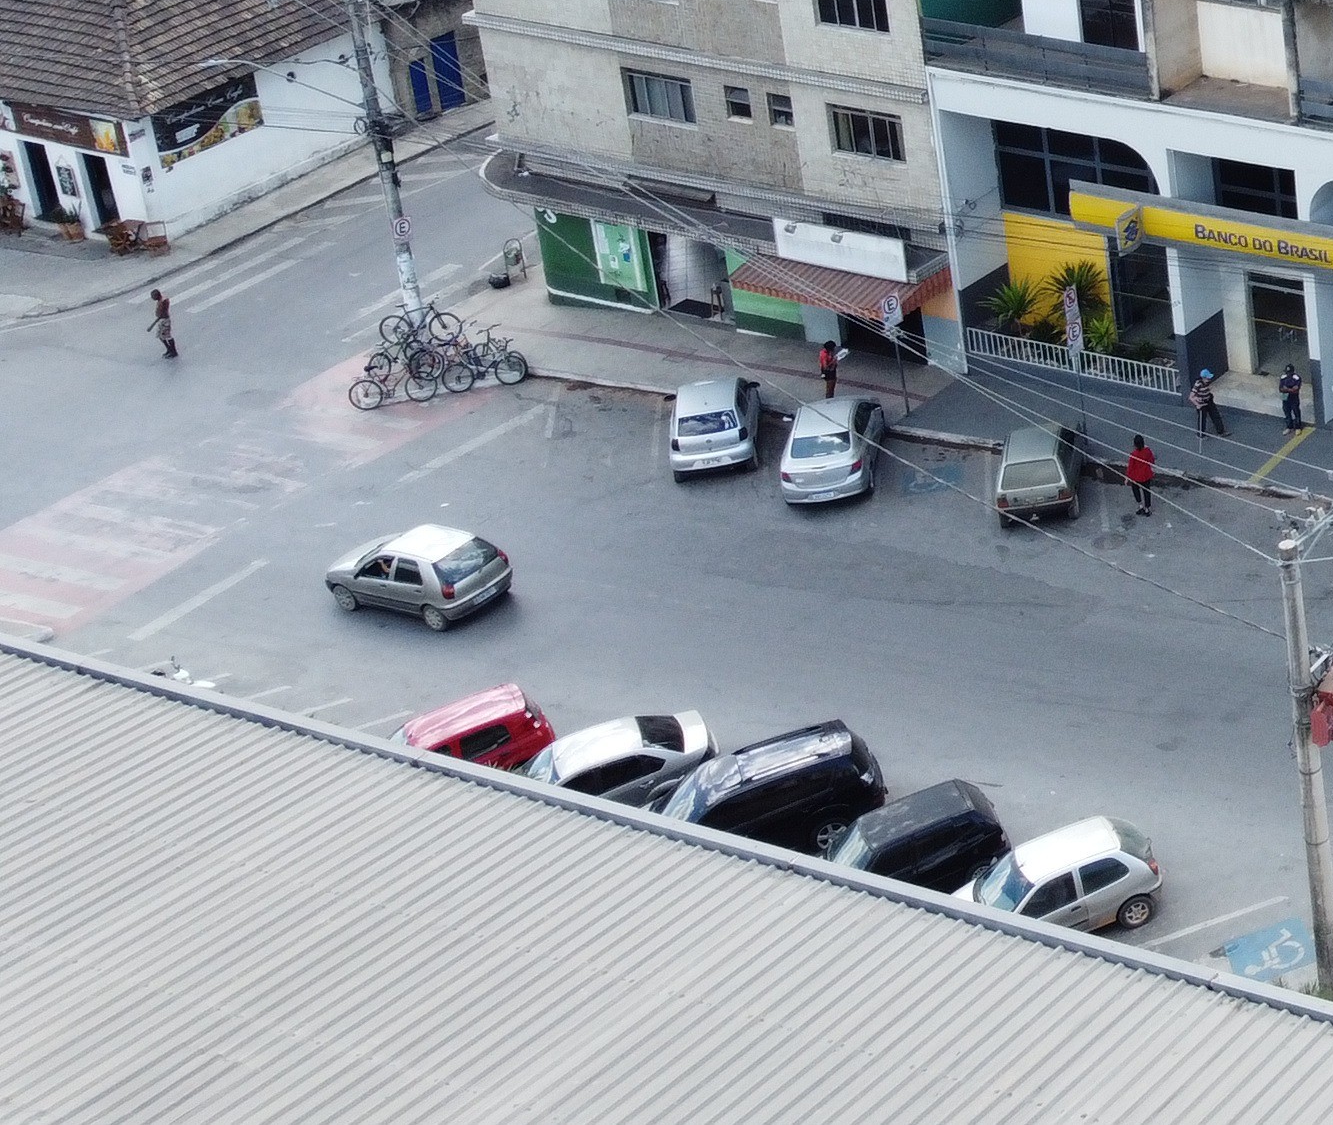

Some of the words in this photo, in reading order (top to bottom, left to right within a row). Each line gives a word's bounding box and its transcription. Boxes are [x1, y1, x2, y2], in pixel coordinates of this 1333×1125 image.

[1194, 224, 1249, 248] BANCO
[1252, 237, 1273, 253] DO
[1278, 239, 1332, 264] BRASIL
